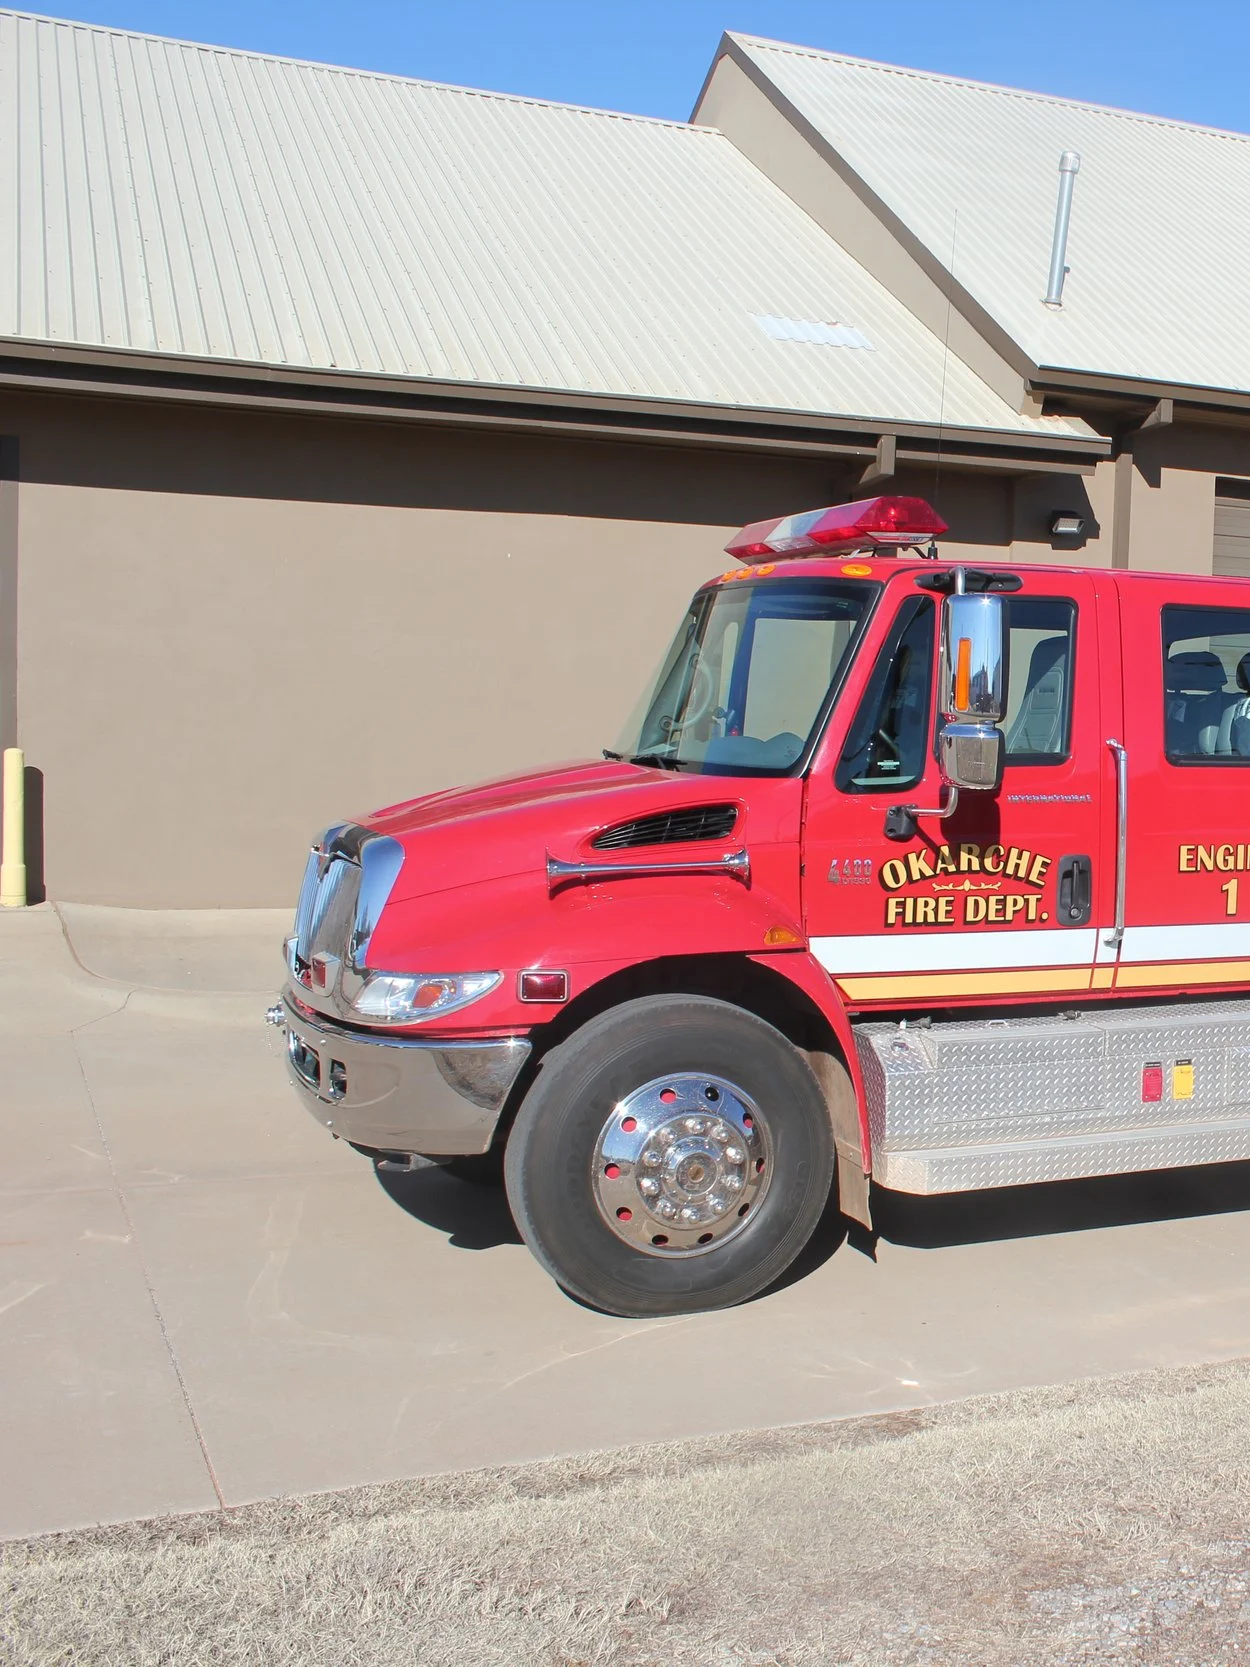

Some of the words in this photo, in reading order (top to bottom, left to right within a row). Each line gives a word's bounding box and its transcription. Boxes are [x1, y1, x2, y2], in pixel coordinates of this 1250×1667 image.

[827, 859, 873, 884] 4400
[880, 842, 1053, 891] OKARCHE
[885, 896, 955, 927] FIRE
[964, 894, 1049, 925] DEPT.
[1221, 878, 1239, 916] 1
